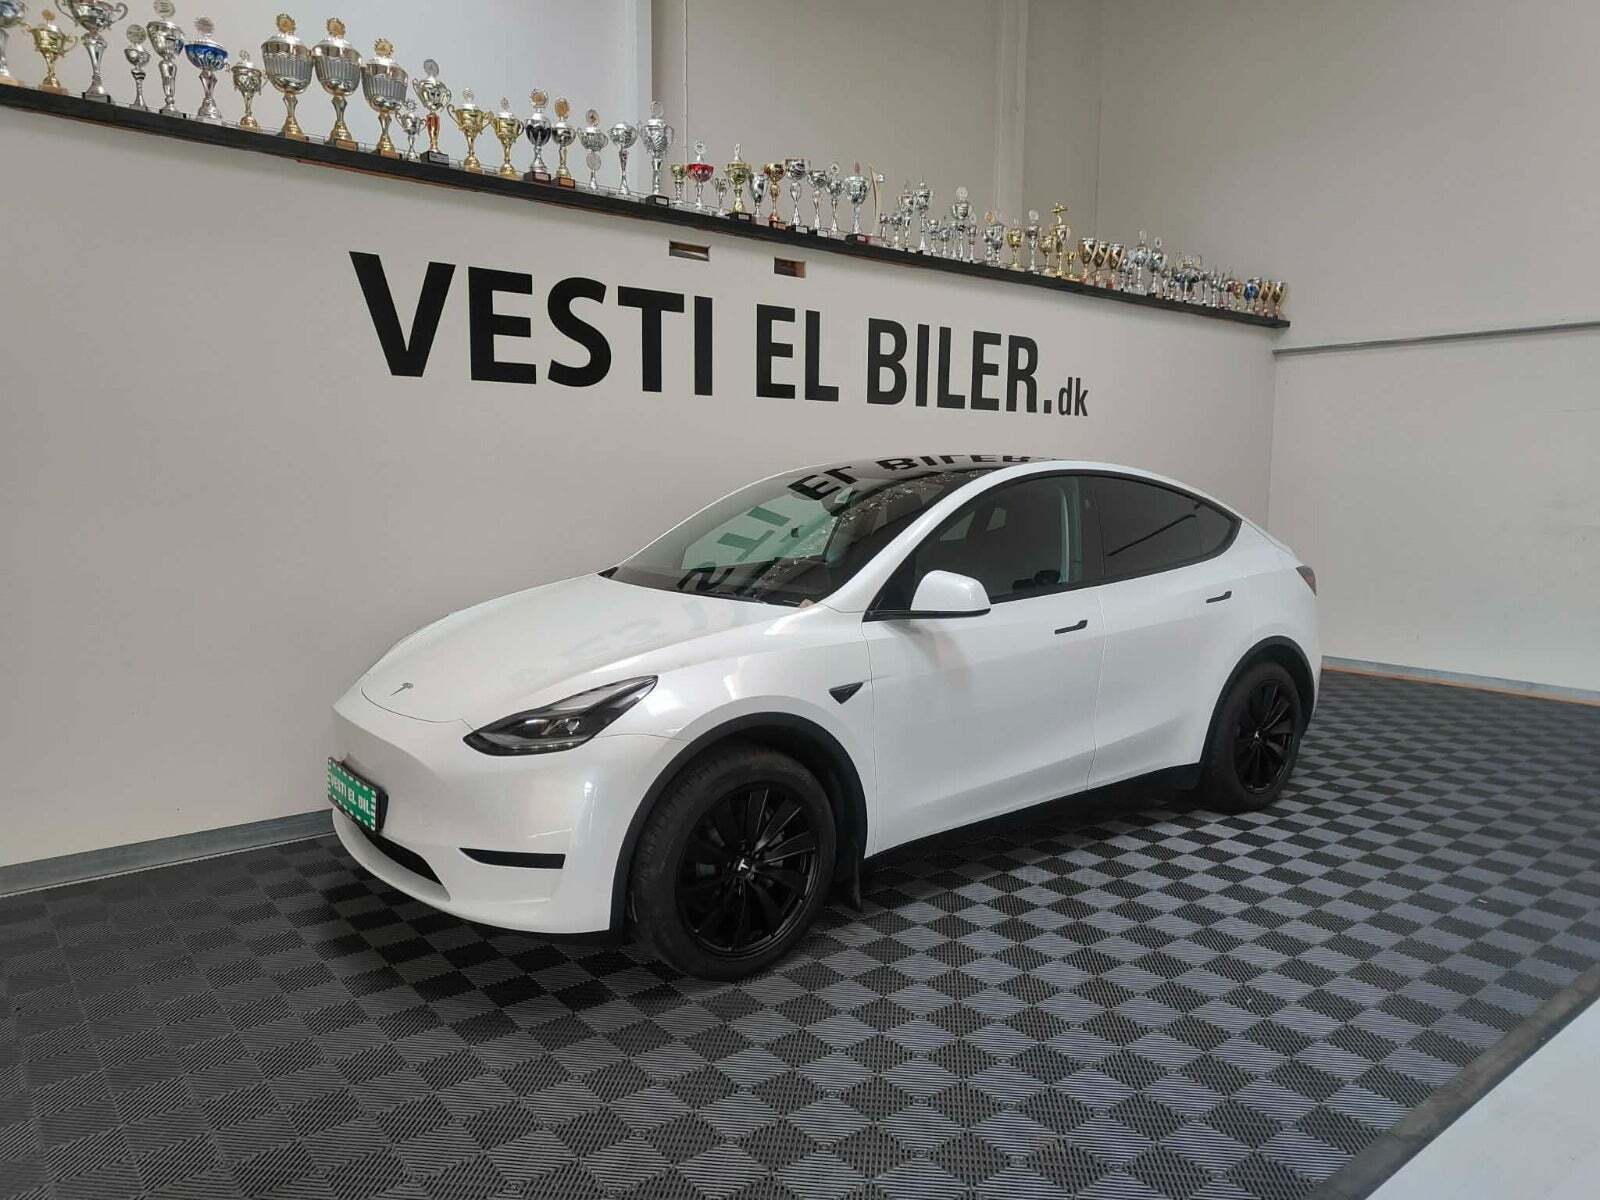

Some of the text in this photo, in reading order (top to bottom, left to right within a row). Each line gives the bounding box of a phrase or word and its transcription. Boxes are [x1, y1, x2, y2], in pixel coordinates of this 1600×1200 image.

[349, 250, 1089, 417] VESTI EL BILER.dk
